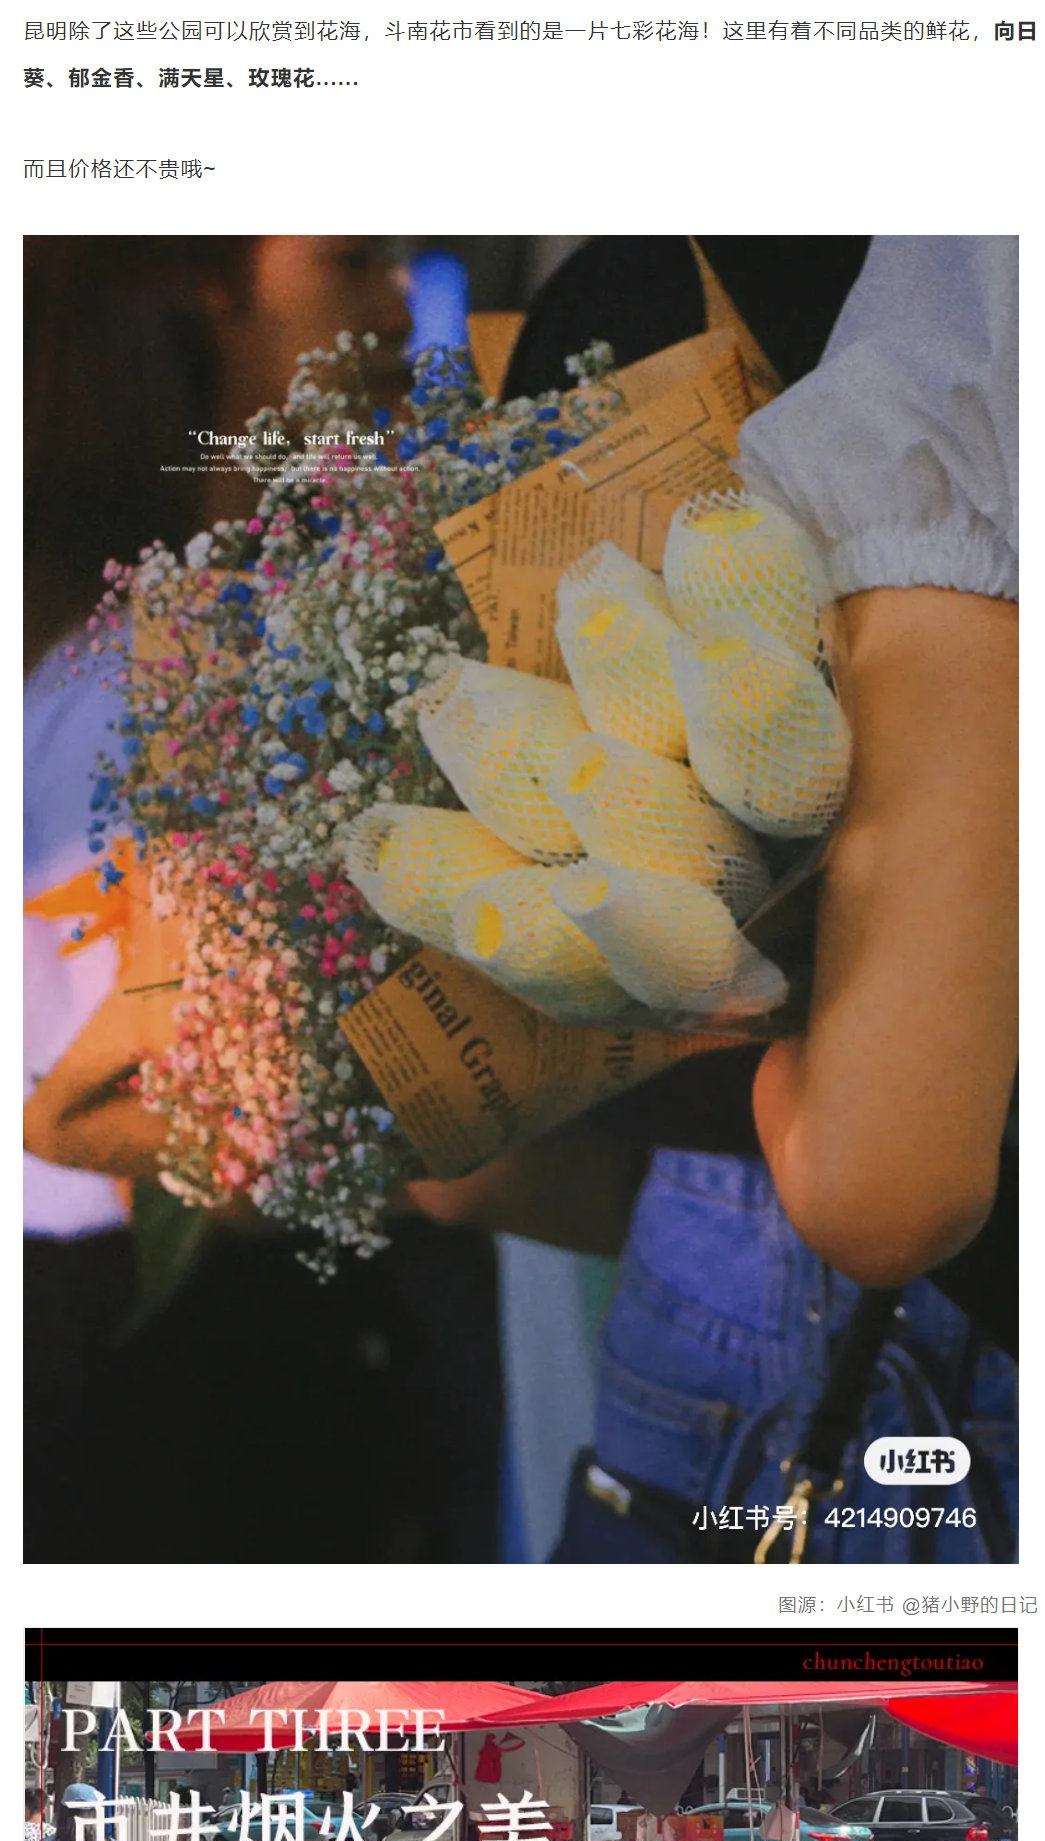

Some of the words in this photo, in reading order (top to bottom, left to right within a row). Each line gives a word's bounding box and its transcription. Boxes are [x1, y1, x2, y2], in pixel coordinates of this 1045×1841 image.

[24, 20, 1036, 42] 昆明除了这些公园可以欣赏到花海，斗南花市看到的是一片七彩花海！这里有着不同品类的鲜花，向日
[902, 1594, 1038, 1616] @猪小野的日记
